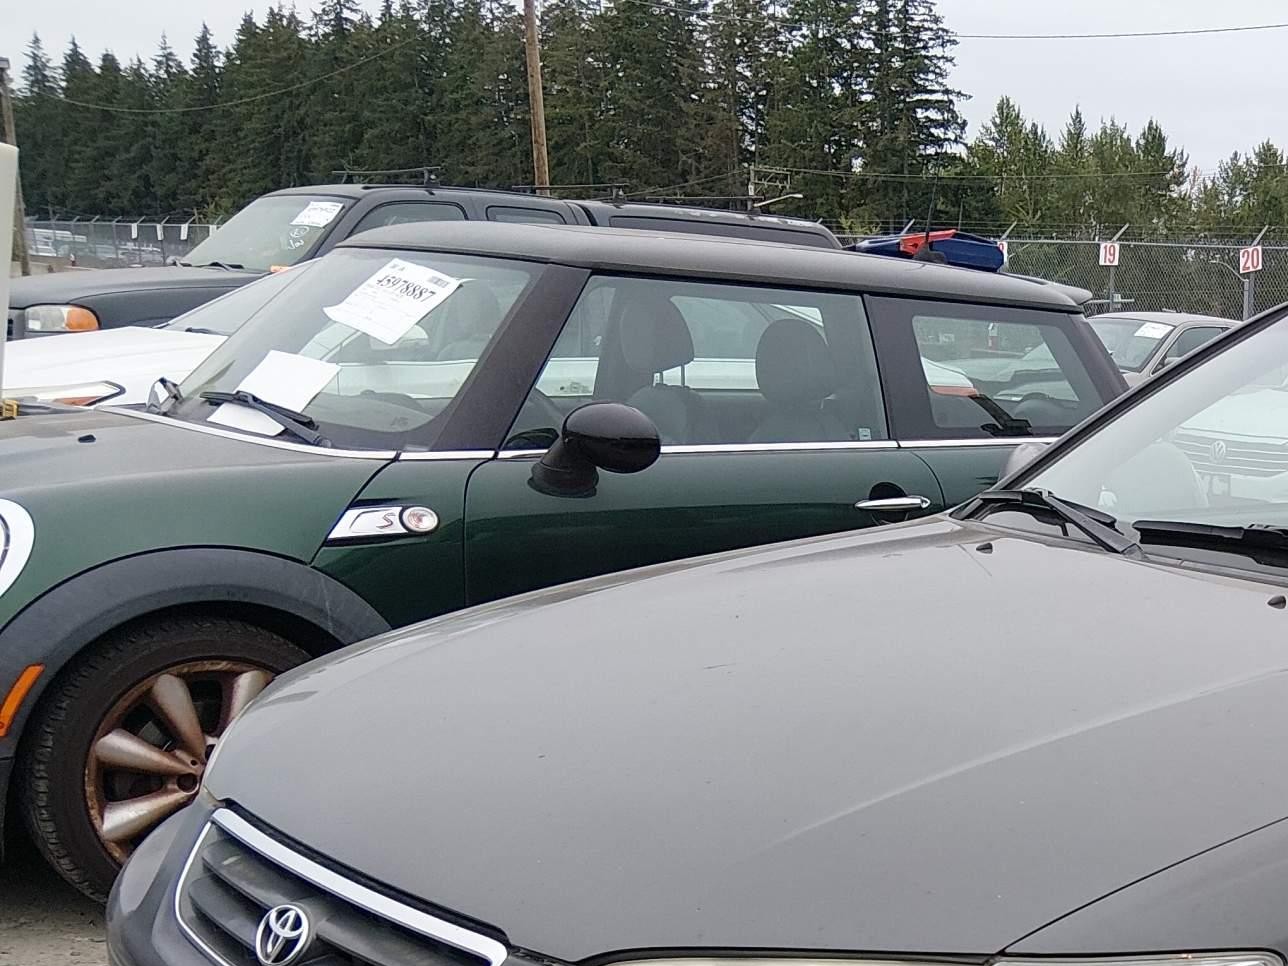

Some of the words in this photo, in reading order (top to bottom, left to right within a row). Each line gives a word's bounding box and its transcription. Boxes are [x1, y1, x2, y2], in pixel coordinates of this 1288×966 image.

[1102, 244, 1116, 264] 19
[1241, 248, 1260, 271] 20
[376, 274, 437, 302] 45978887
[376, 512, 396, 530] S
